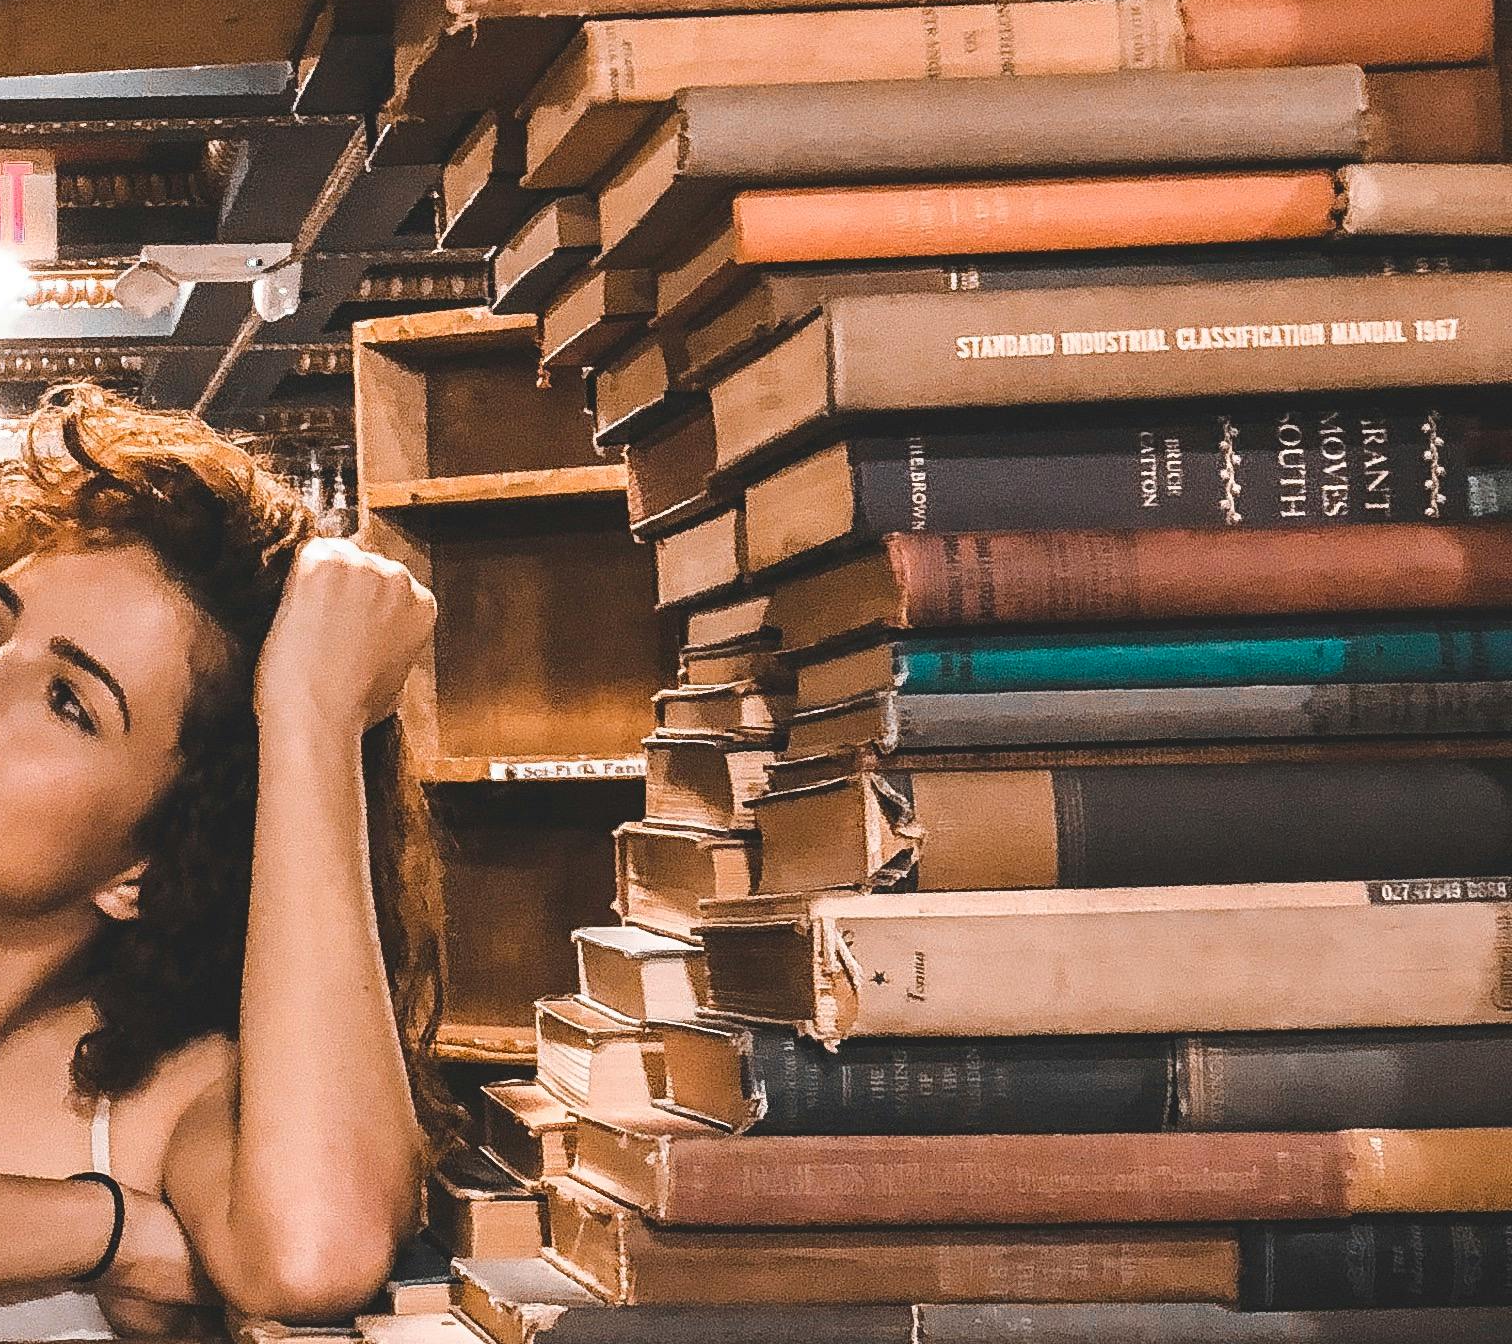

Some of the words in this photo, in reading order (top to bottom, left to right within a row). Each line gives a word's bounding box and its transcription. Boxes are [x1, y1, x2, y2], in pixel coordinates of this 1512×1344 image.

[955, 333, 1055, 360] STANDARD
[1060, 329, 1169, 357] INDUSTRIAL
[1176, 323, 1325, 352] CLASSIFICATION
[1331, 320, 1407, 346] MANUAL
[1413, 318, 1458, 344] 1967
[1140, 431, 1156, 507] CATTON
[1166, 438, 1182, 497] BRUCE
